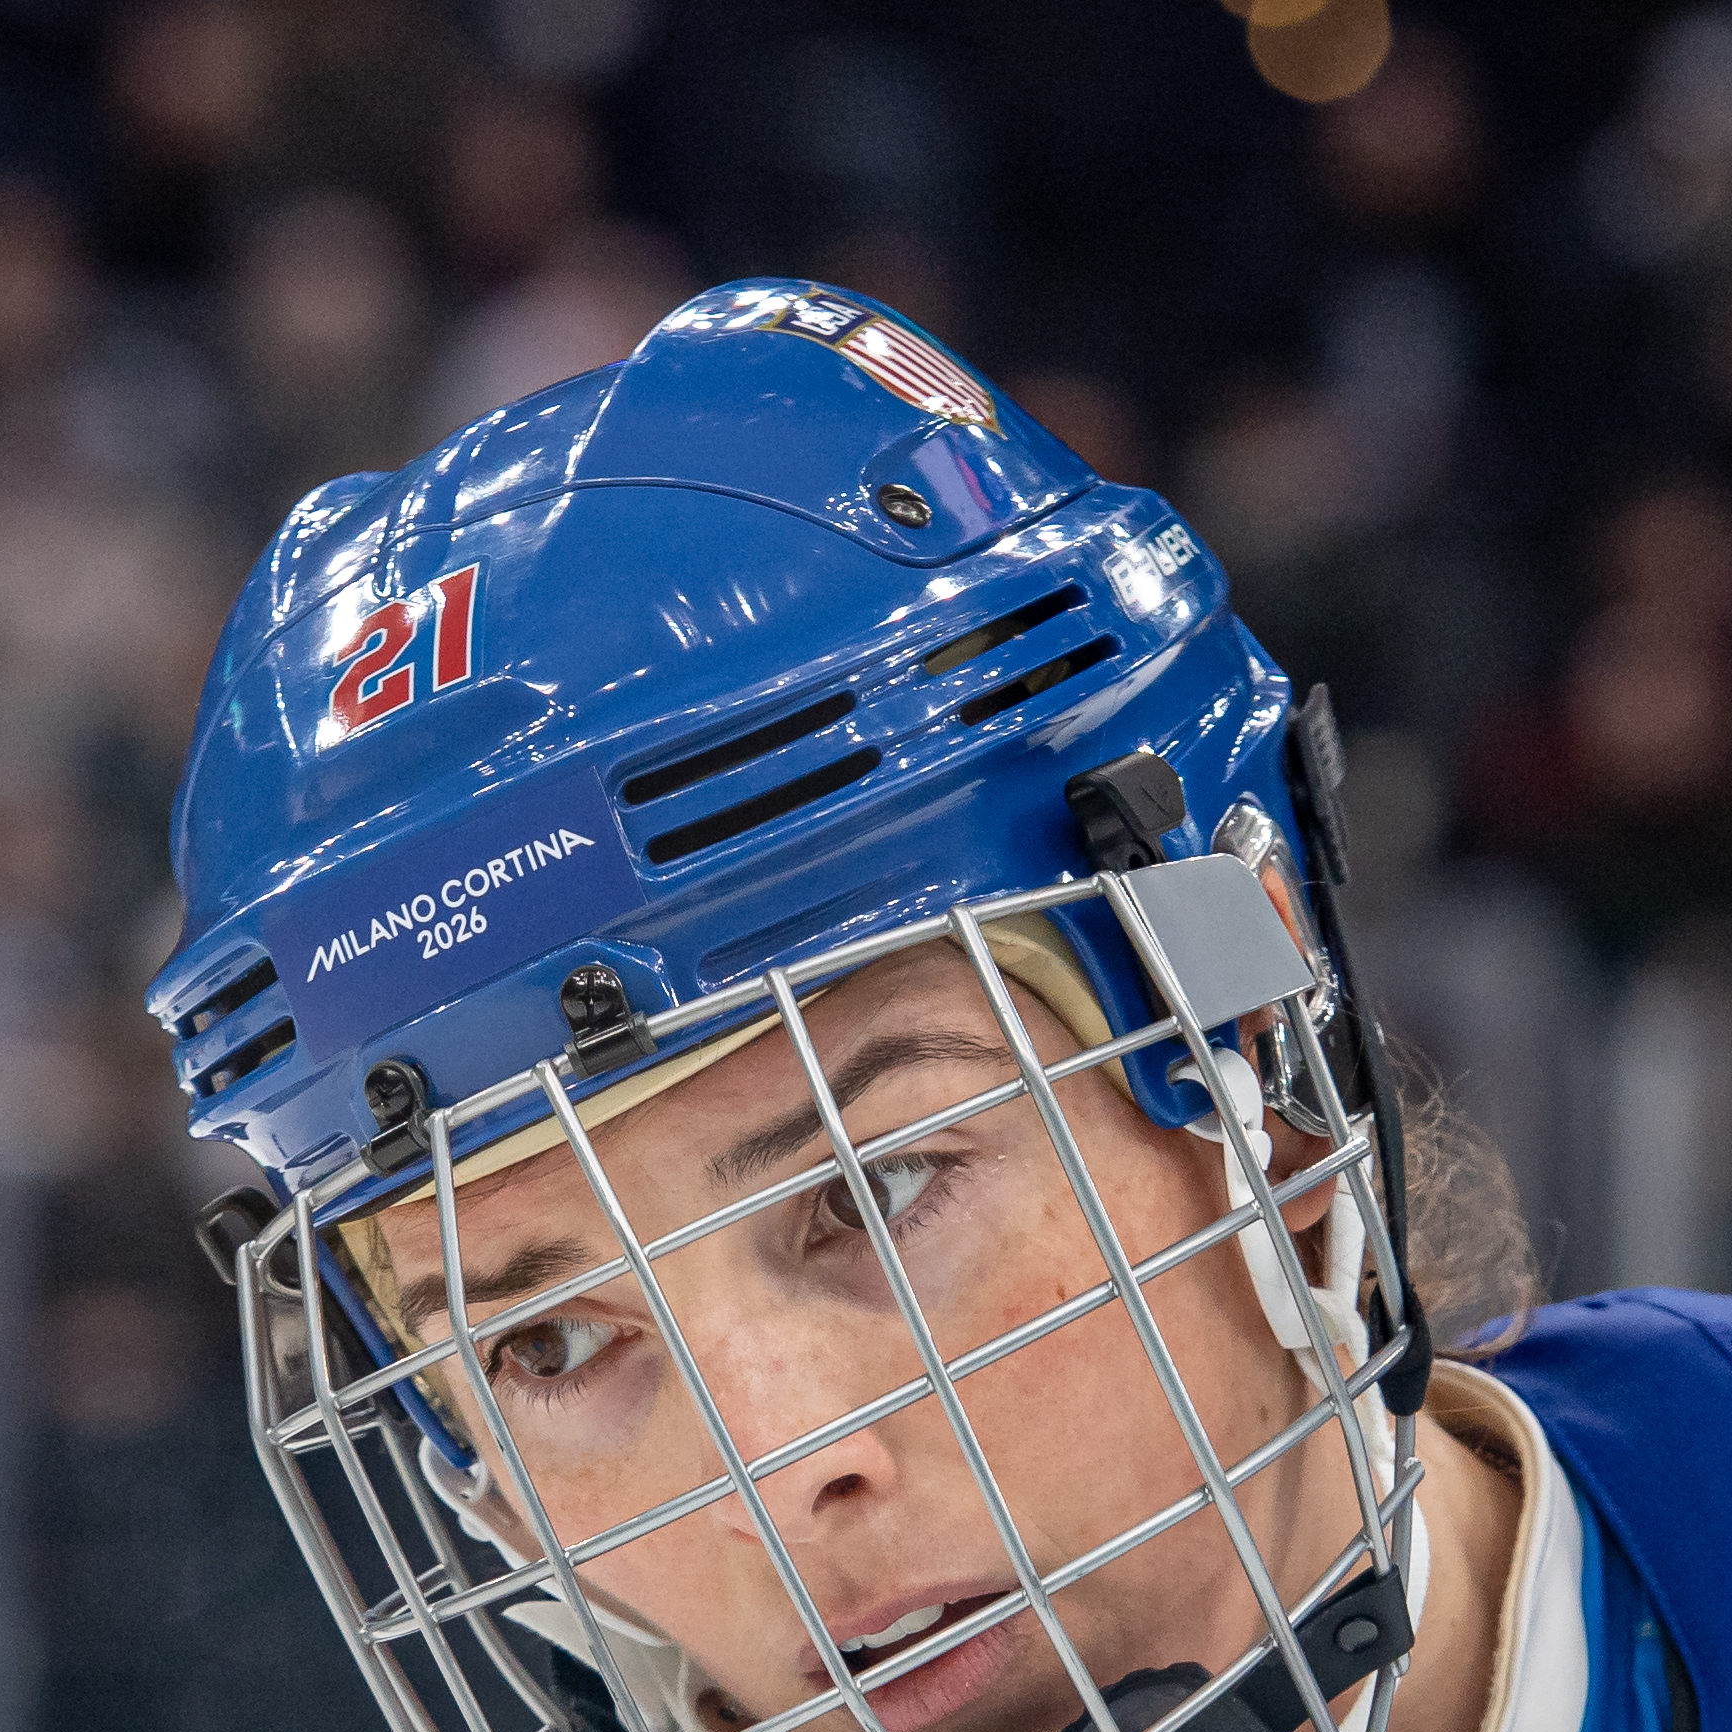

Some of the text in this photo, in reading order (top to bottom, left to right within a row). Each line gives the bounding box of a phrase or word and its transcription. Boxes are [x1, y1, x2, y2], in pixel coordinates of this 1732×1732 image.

[316, 561, 481, 754] 21
[307, 828, 596, 983] MILANO CORTINA
[417, 906, 487, 960] 2026
